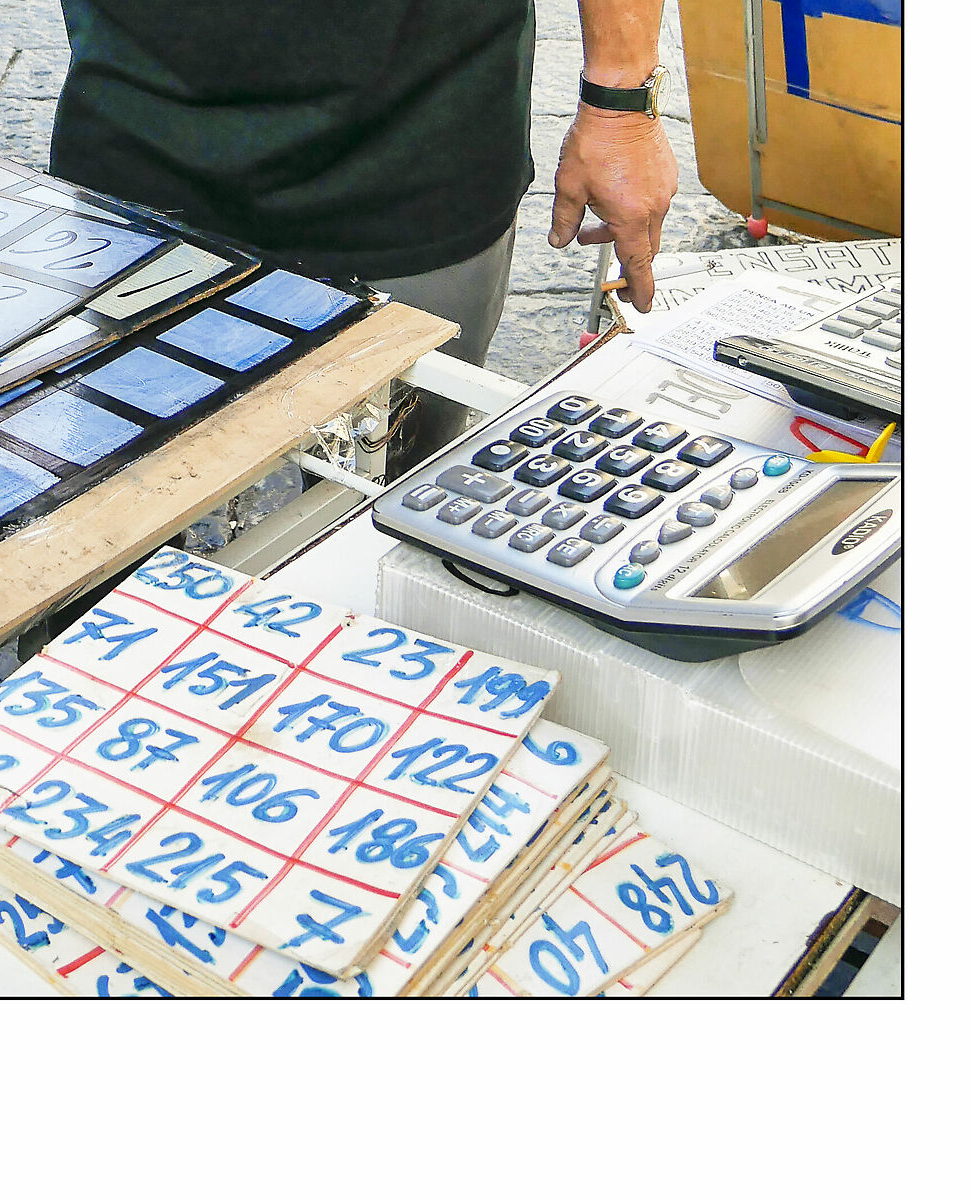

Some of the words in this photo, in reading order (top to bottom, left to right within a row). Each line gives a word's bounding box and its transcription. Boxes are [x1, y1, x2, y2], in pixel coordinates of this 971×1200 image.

[673, 564, 690, 575] 12
[841, 513, 889, 546] KADIO
[63, 607, 160, 660] 71
[154, 652, 278, 710] 151
[270, 693, 391, 755] 170
[382, 736, 500, 795] 122
[134, 550, 234, 600] 250
[231, 594, 323, 638] 42
[341, 627, 453, 681] 23
[453, 666, 552, 720] 199
[7, 778, 142, 857] 234
[125, 830, 269, 905] 215
[278, 888, 372, 950] 7
[94, 717, 200, 771] 87
[196, 763, 321, 825] 106
[326, 808, 446, 870] 186
